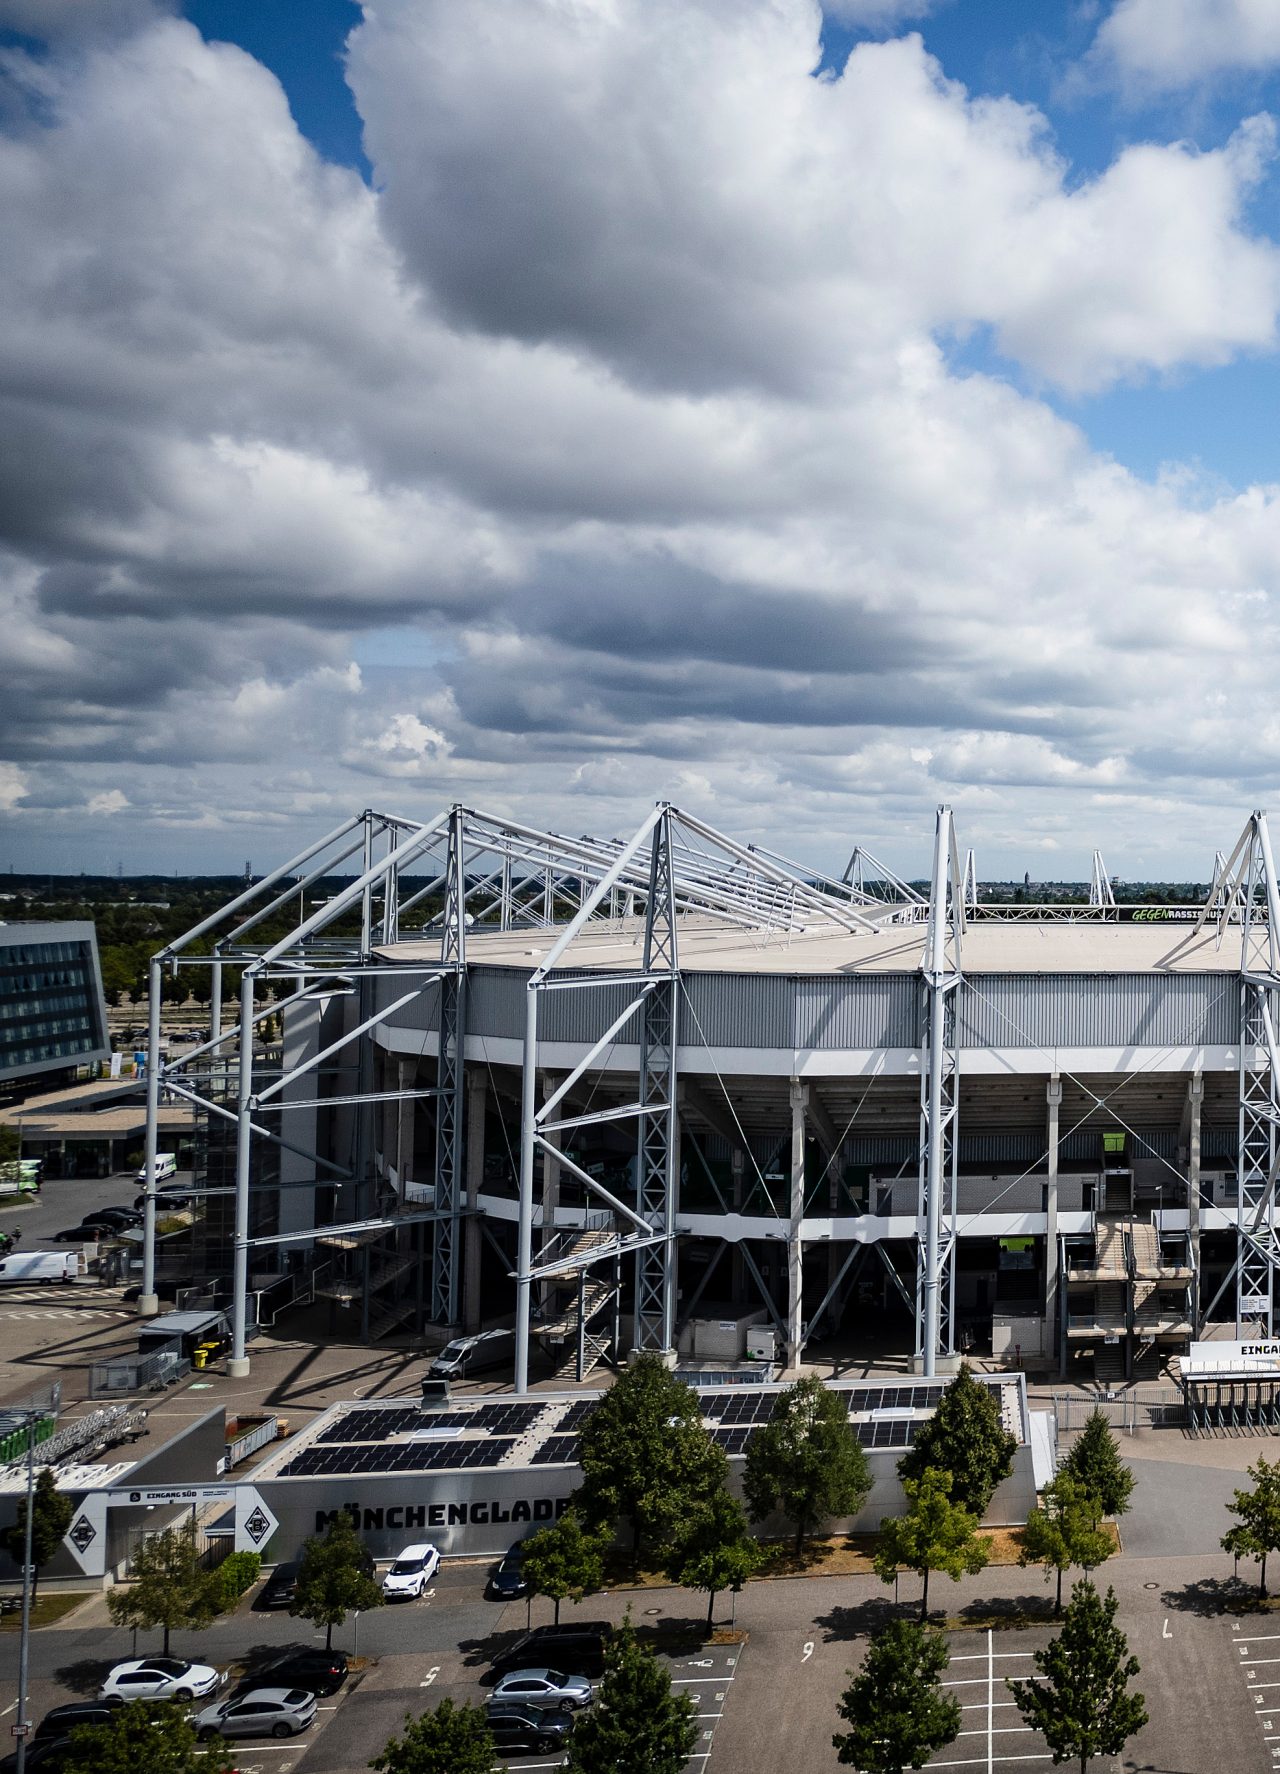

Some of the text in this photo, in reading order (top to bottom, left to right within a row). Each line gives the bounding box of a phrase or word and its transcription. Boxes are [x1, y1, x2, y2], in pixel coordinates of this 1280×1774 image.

[1132, 908, 1169, 921] GEGEN
[147, 1491, 181, 1499] EINGANG
[181, 1490, 197, 1498] SÜD
